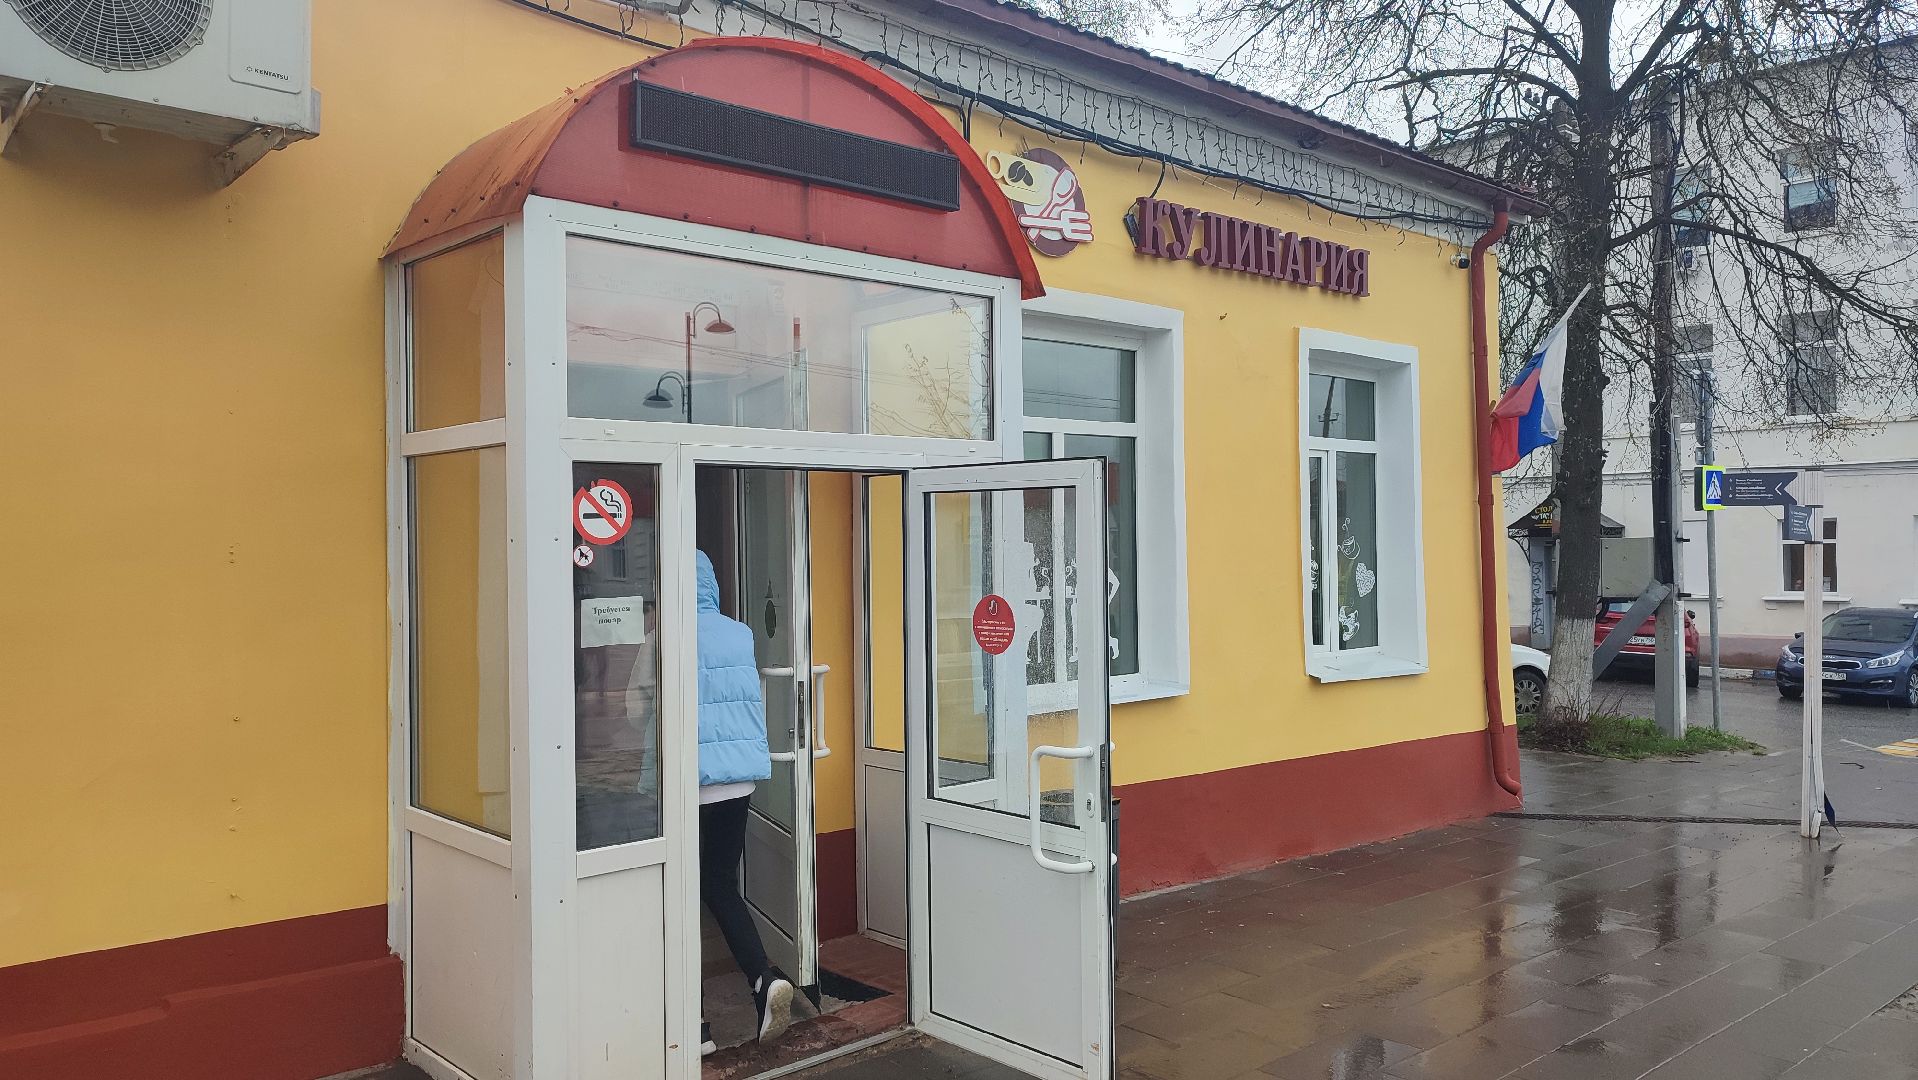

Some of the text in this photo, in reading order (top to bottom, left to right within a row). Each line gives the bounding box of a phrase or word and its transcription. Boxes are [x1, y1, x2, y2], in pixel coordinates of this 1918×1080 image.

[254, 67, 289, 81] KENTATSU
[1136, 197, 1371, 297] КУЛИНАРИЯ
[592, 605, 631, 616] Требуется
[598, 617, 622, 625] повар
